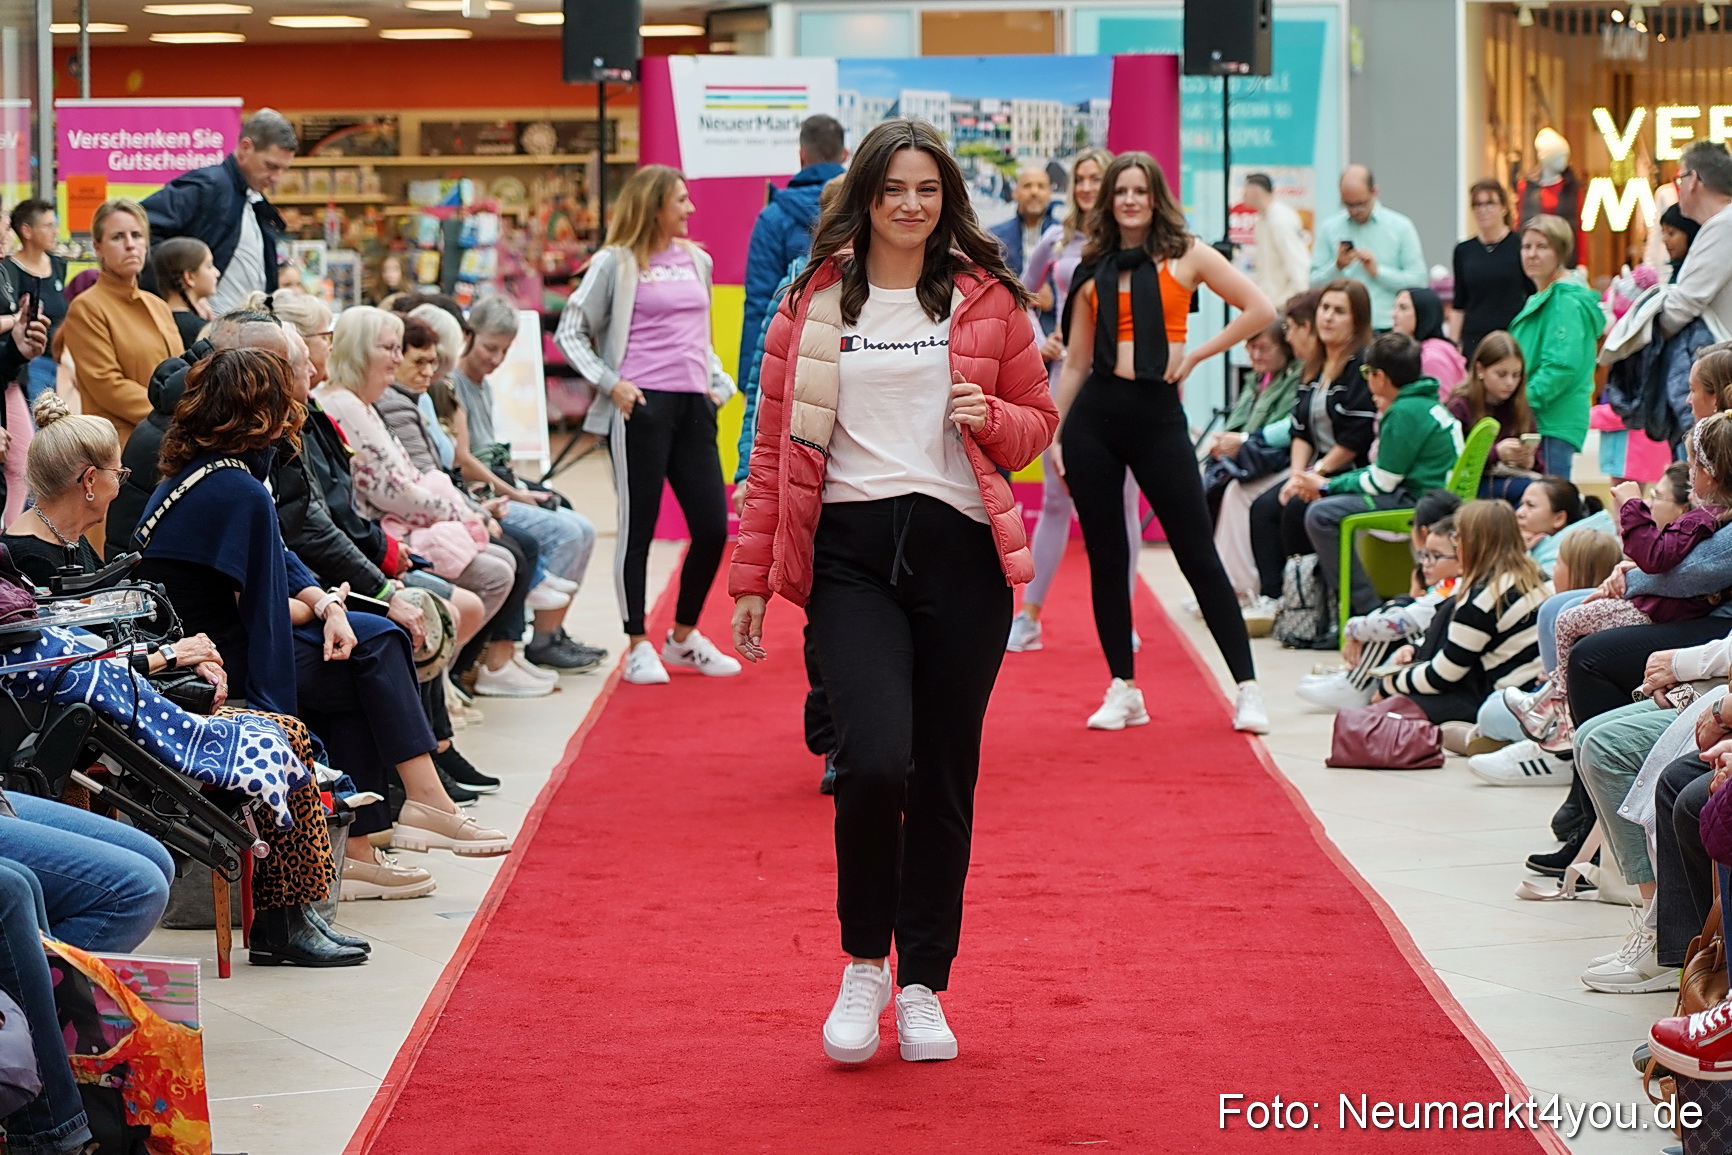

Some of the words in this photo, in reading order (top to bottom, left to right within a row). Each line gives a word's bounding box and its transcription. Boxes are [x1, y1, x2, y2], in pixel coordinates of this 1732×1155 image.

[699, 115, 802, 131] NeuerMark
[67, 128, 191, 149] Verschenken
[191, 128, 224, 149] Sie
[840, 334, 949, 356] Champio
